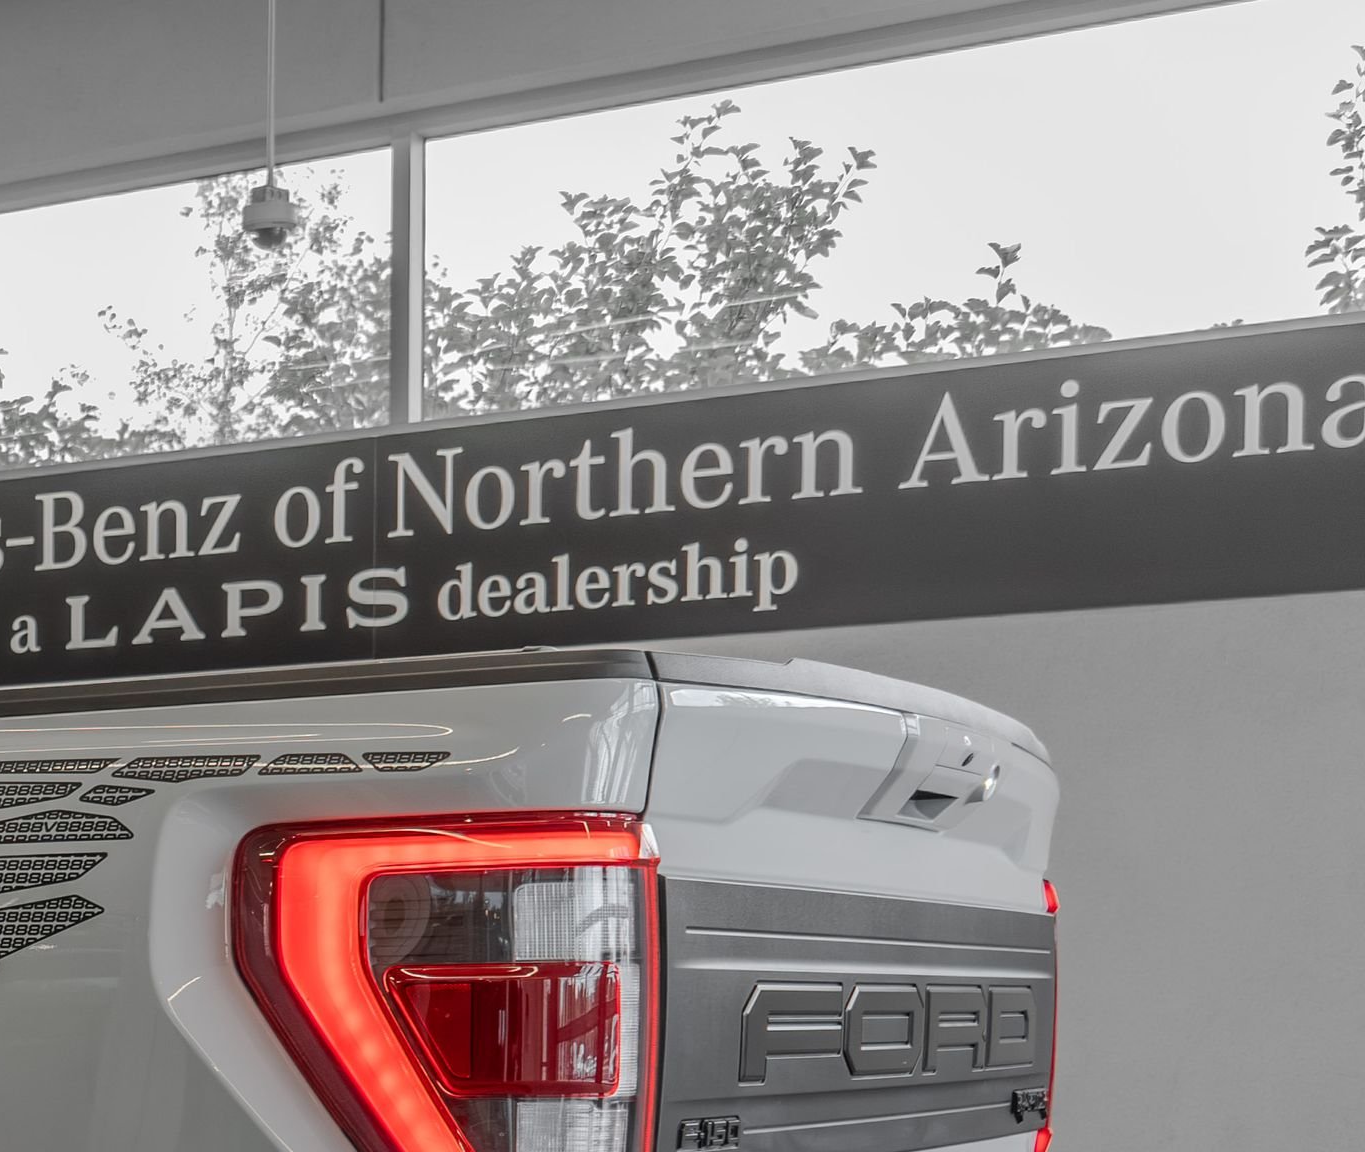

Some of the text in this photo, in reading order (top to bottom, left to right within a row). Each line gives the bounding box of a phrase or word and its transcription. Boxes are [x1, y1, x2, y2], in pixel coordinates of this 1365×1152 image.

[273, 458, 364, 549] of
[387, 426, 863, 539] Northern
[9, 537, 799, 654] a LAPIS dealership
[739, 980, 1035, 1086] FORD
